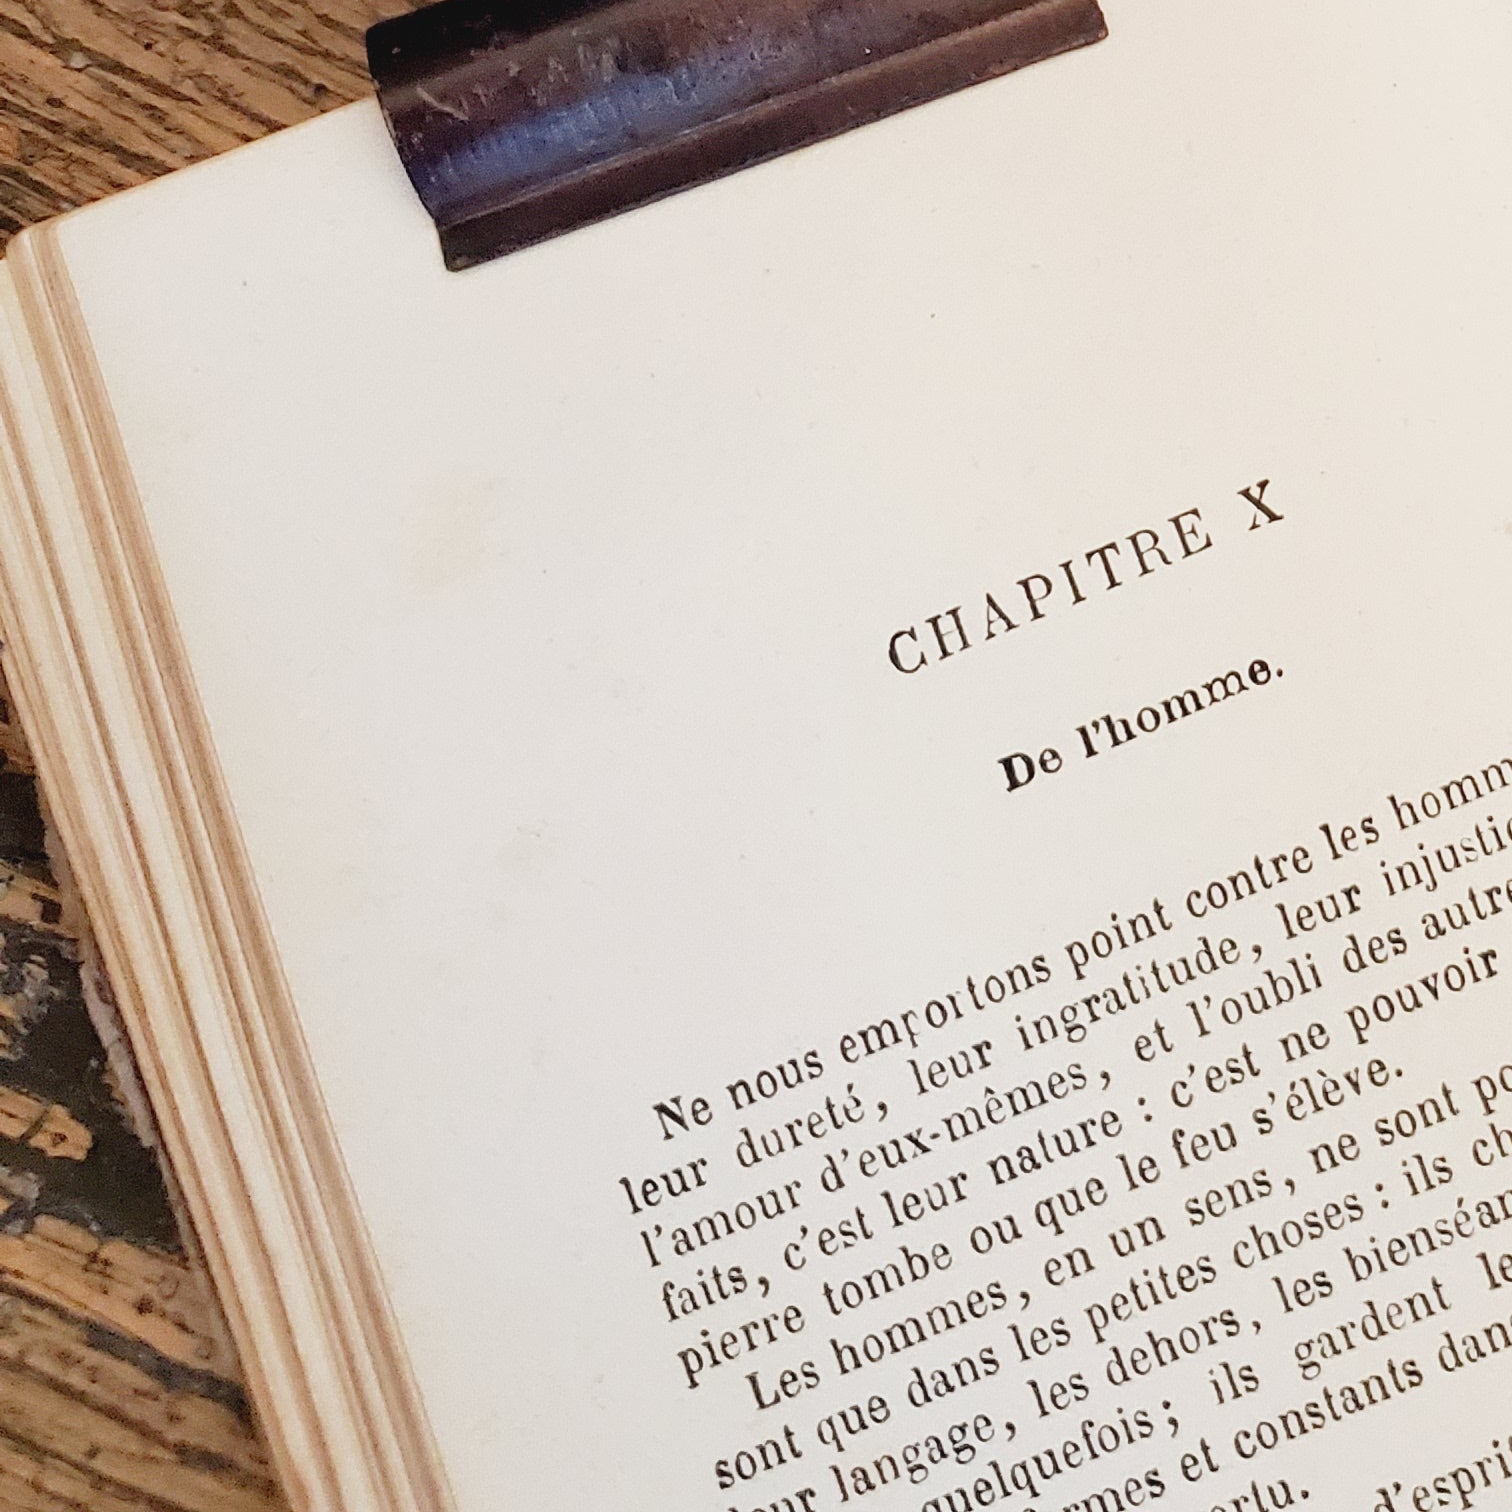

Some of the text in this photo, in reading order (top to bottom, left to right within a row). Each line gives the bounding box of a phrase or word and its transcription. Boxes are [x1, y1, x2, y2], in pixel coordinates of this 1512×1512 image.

[887, 477, 1286, 675] CHAPITRE X
[996, 658, 1285, 794] De l'homme.
[617, 1156, 709, 1216] leur
[735, 1081, 889, 1169] dureté,
[905, 1038, 994, 1097] leur
[1013, 935, 1264, 1052] ingratitude,
[1273, 883, 1362, 941] leur
[639, 1178, 803, 1269] l'amour
[819, 1061, 1112, 1194] d'eux-mêmes,
[1133, 1018, 1175, 1064] et
[1184, 951, 1324, 1039] l'oubli
[1341, 926, 1409, 975] des
[650, 1094, 714, 1142] Ne
[724, 1048, 825, 1111] nous
[1063, 896, 1174, 982] point
[1185, 845, 1315, 919] contre
[1317, 814, 1381, 862] les
[676, 1057, 1404, 1391] pierre tombe ou que le feu s'élève.
[1207, 1360, 1261, 1406] ils
[1293, 1275, 1453, 1382] gardent
